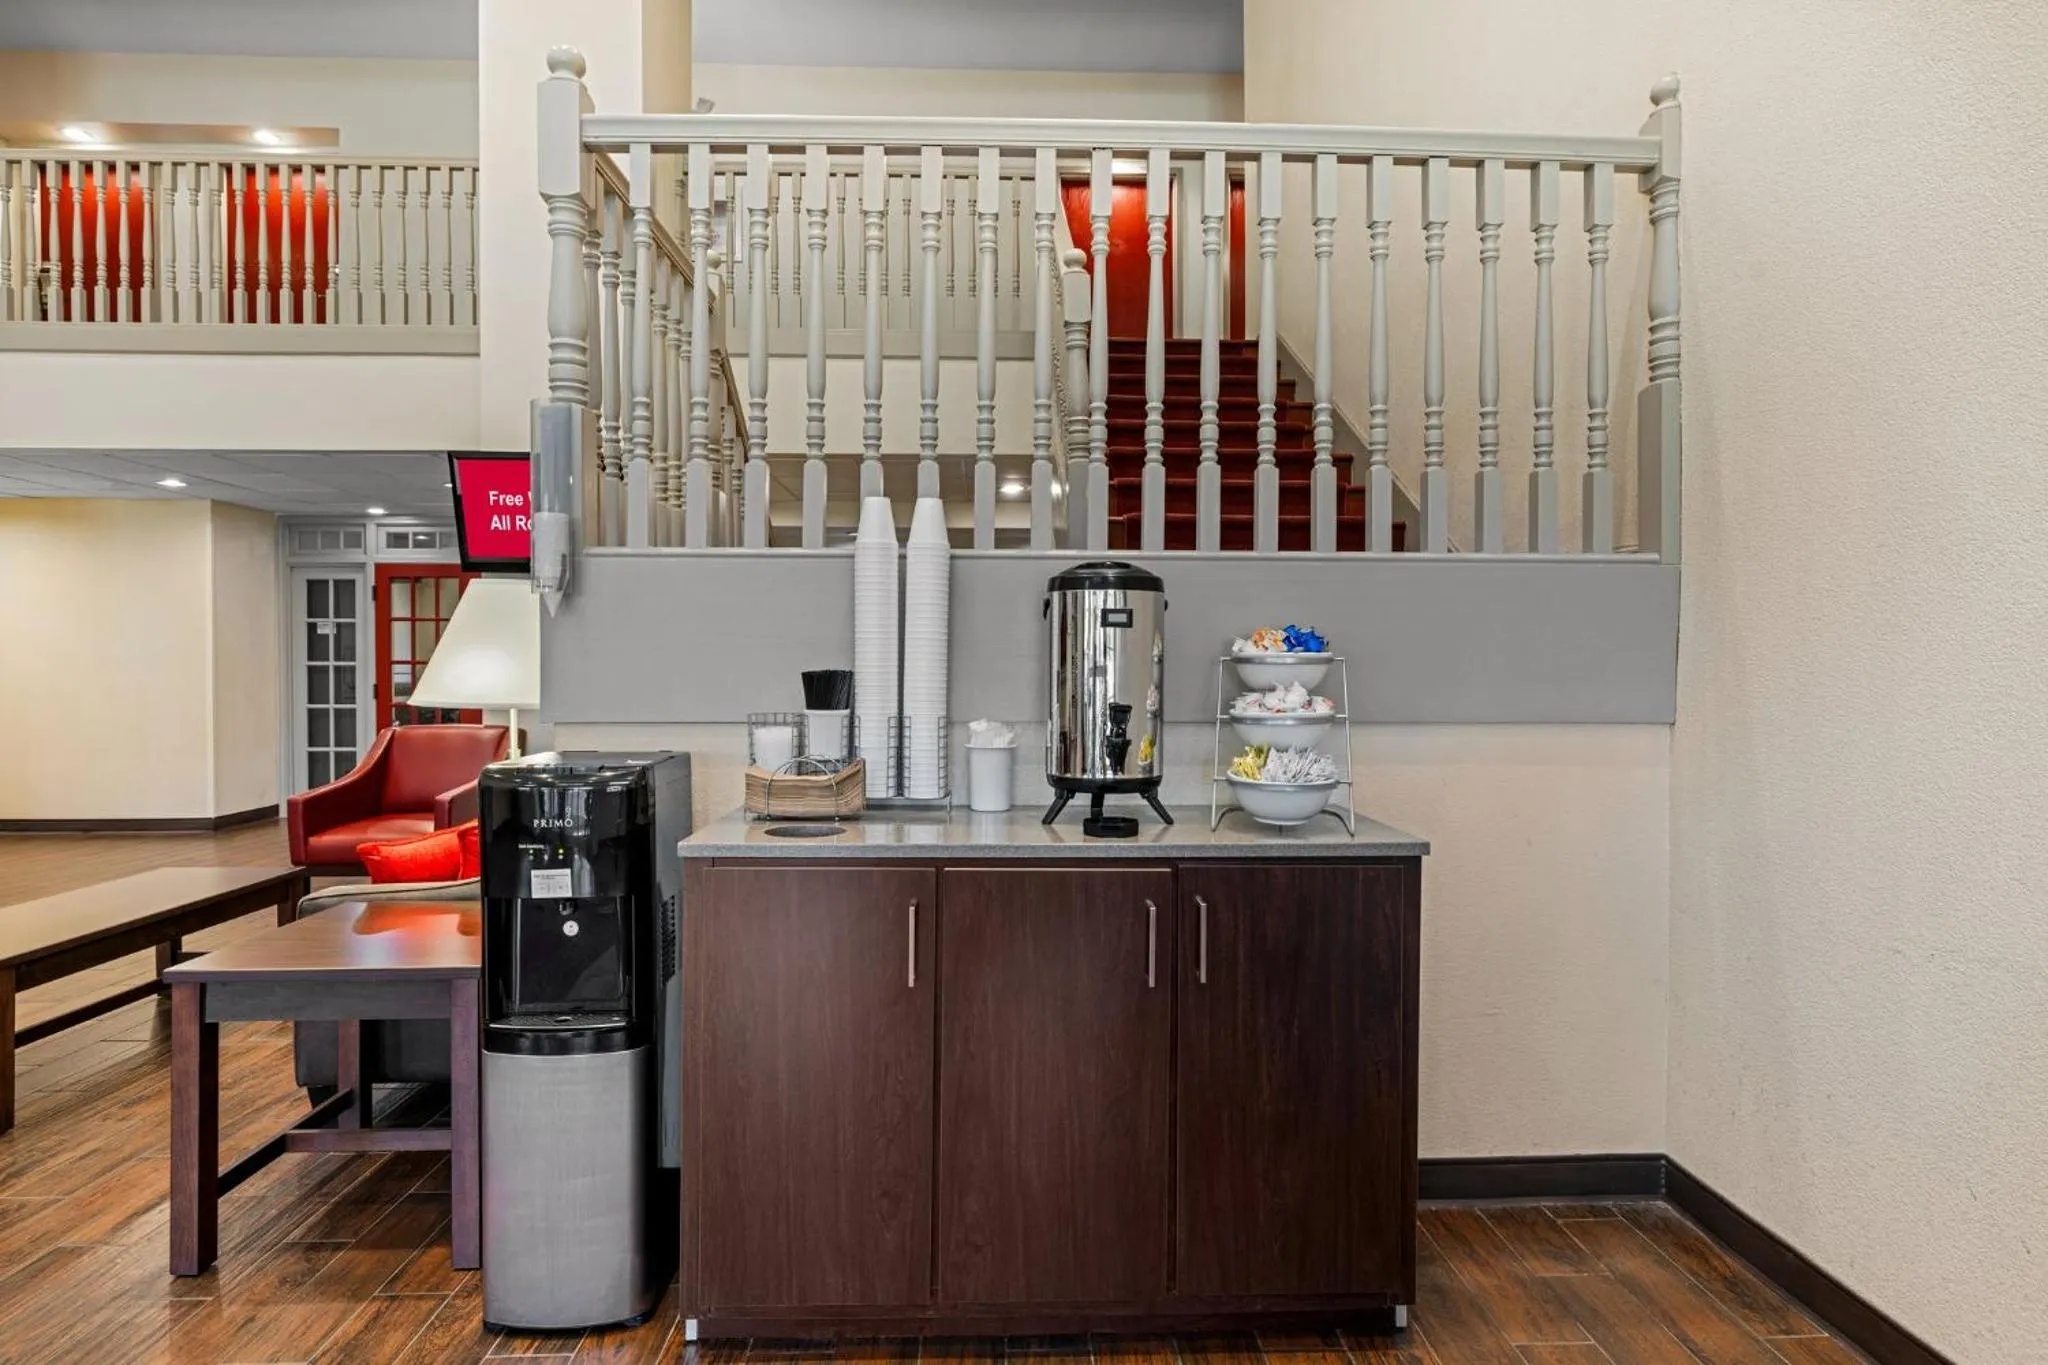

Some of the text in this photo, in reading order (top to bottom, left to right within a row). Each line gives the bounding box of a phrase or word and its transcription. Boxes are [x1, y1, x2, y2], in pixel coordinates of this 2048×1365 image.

[489, 491, 524, 506] Free
[491, 515, 511, 531] All
[533, 818, 573, 828] PRIMO
